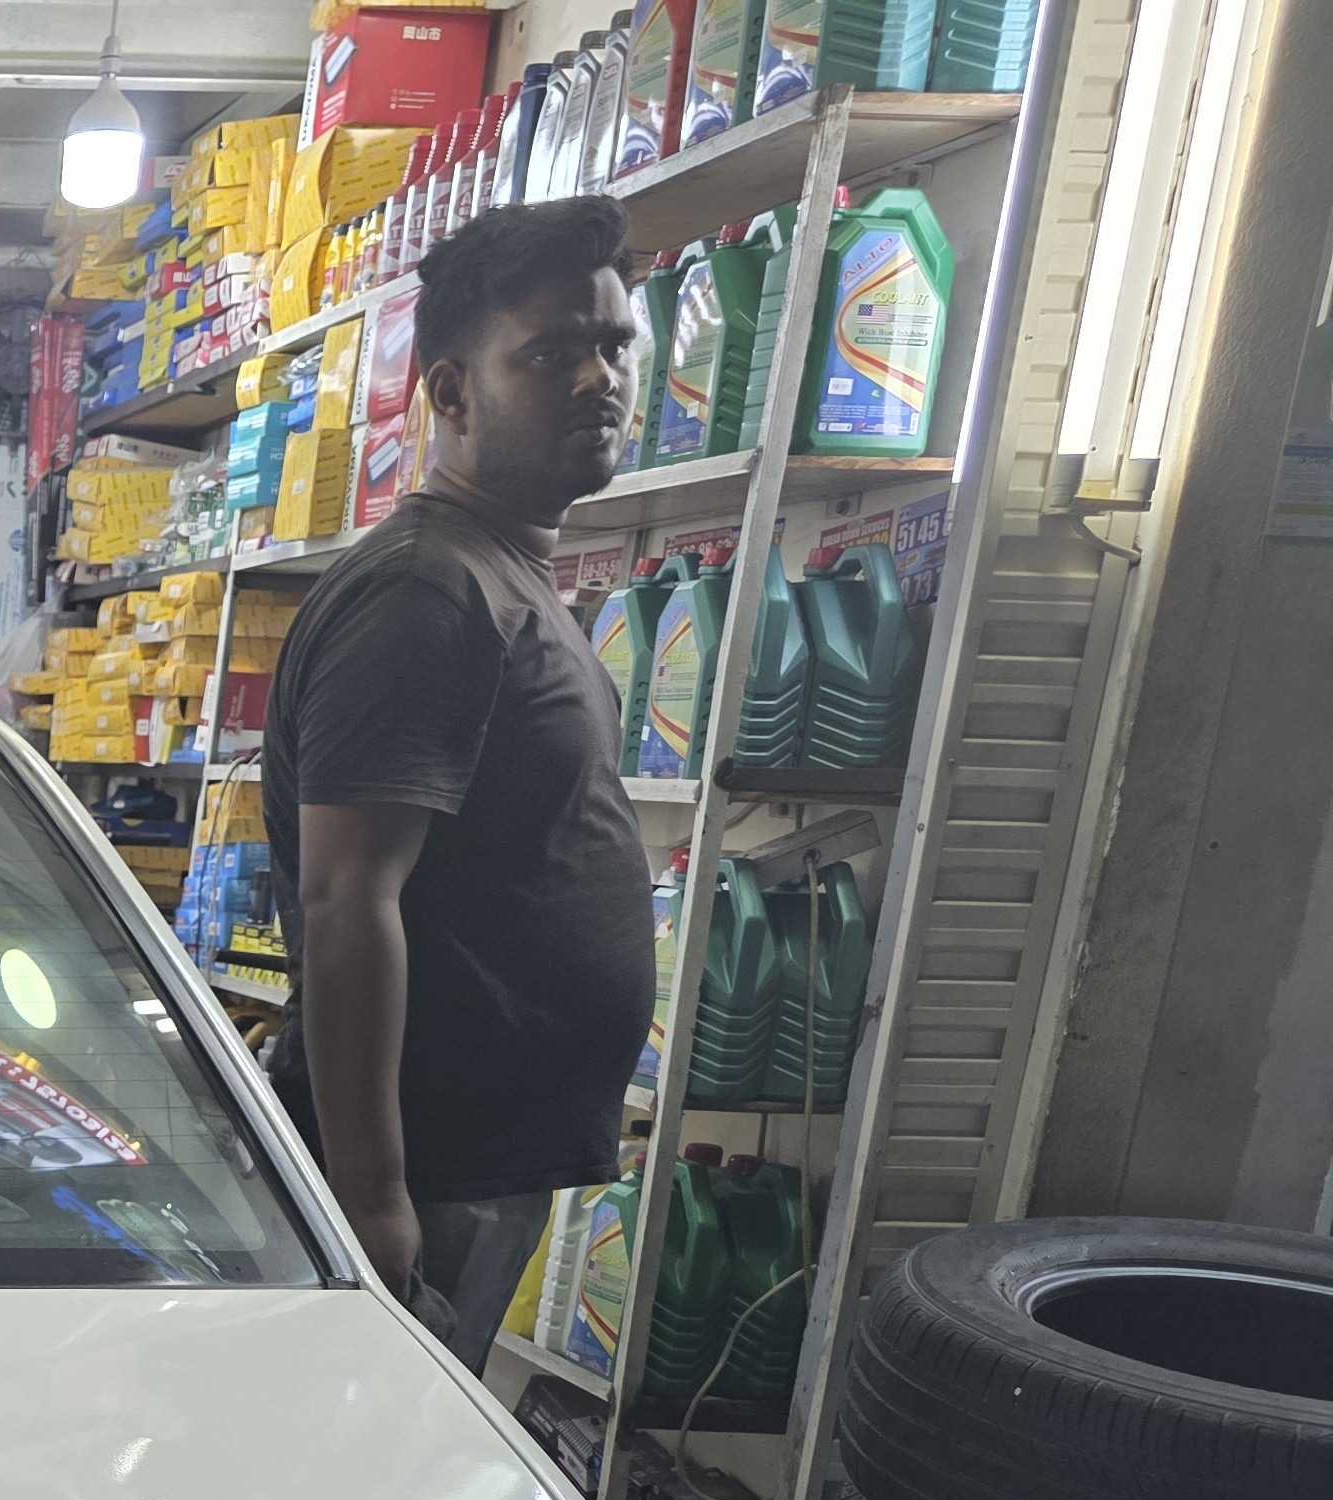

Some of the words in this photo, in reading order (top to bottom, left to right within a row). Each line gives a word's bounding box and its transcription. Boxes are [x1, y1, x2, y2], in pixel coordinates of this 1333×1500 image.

[842, 237, 894, 284] ALTO
[871, 291, 931, 306] COOLANT
[897, 520, 917, 552] 51
[917, 512, 941, 544] 45
